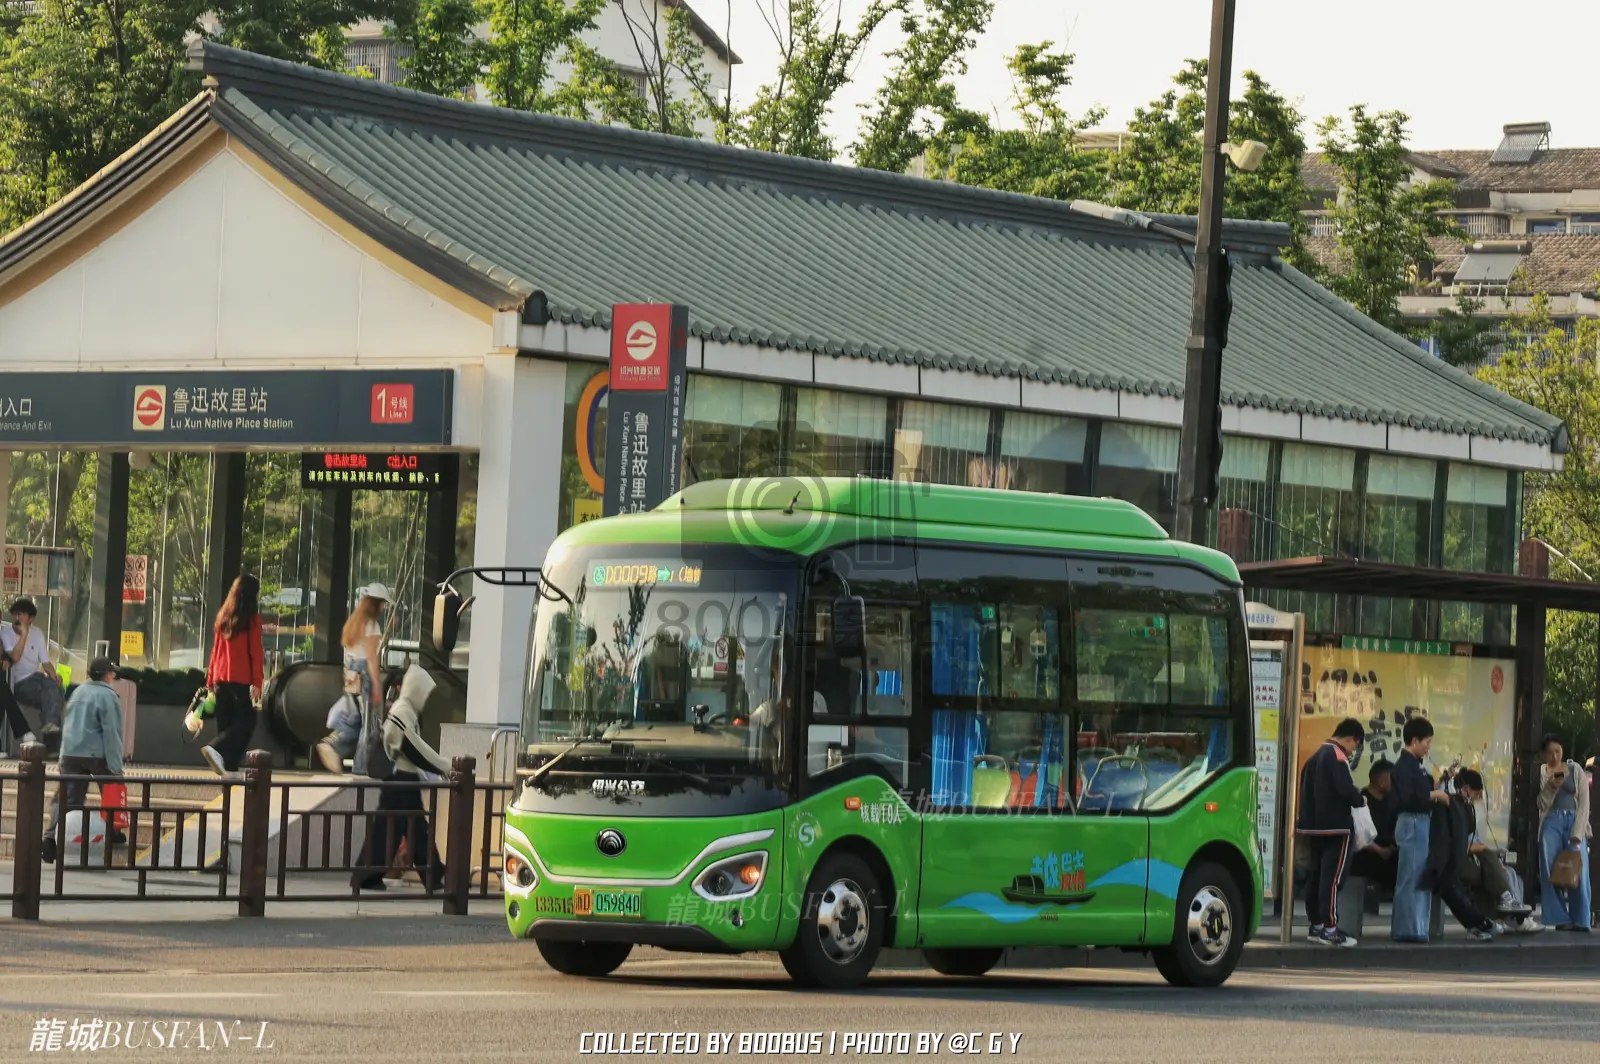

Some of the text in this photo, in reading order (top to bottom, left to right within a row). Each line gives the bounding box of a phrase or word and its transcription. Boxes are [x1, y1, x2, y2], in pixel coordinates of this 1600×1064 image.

[0, 397, 32, 417] 入口
[172, 386, 268, 414] 鲁迅故里站
[376, 387, 408, 420] 1 号线
[21, 421, 37, 430] And
[38, 421, 52, 430] Exit
[170, 417, 293, 429] Lu Xun Native Place Station
[623, 411, 630, 423] Lu
[325, 453, 417, 468] 鲁迅故里站 C出入口
[620, 445, 628, 476] Native
[630, 411, 649, 514] 鲁迅故里站
[619, 478, 627, 502] Place
